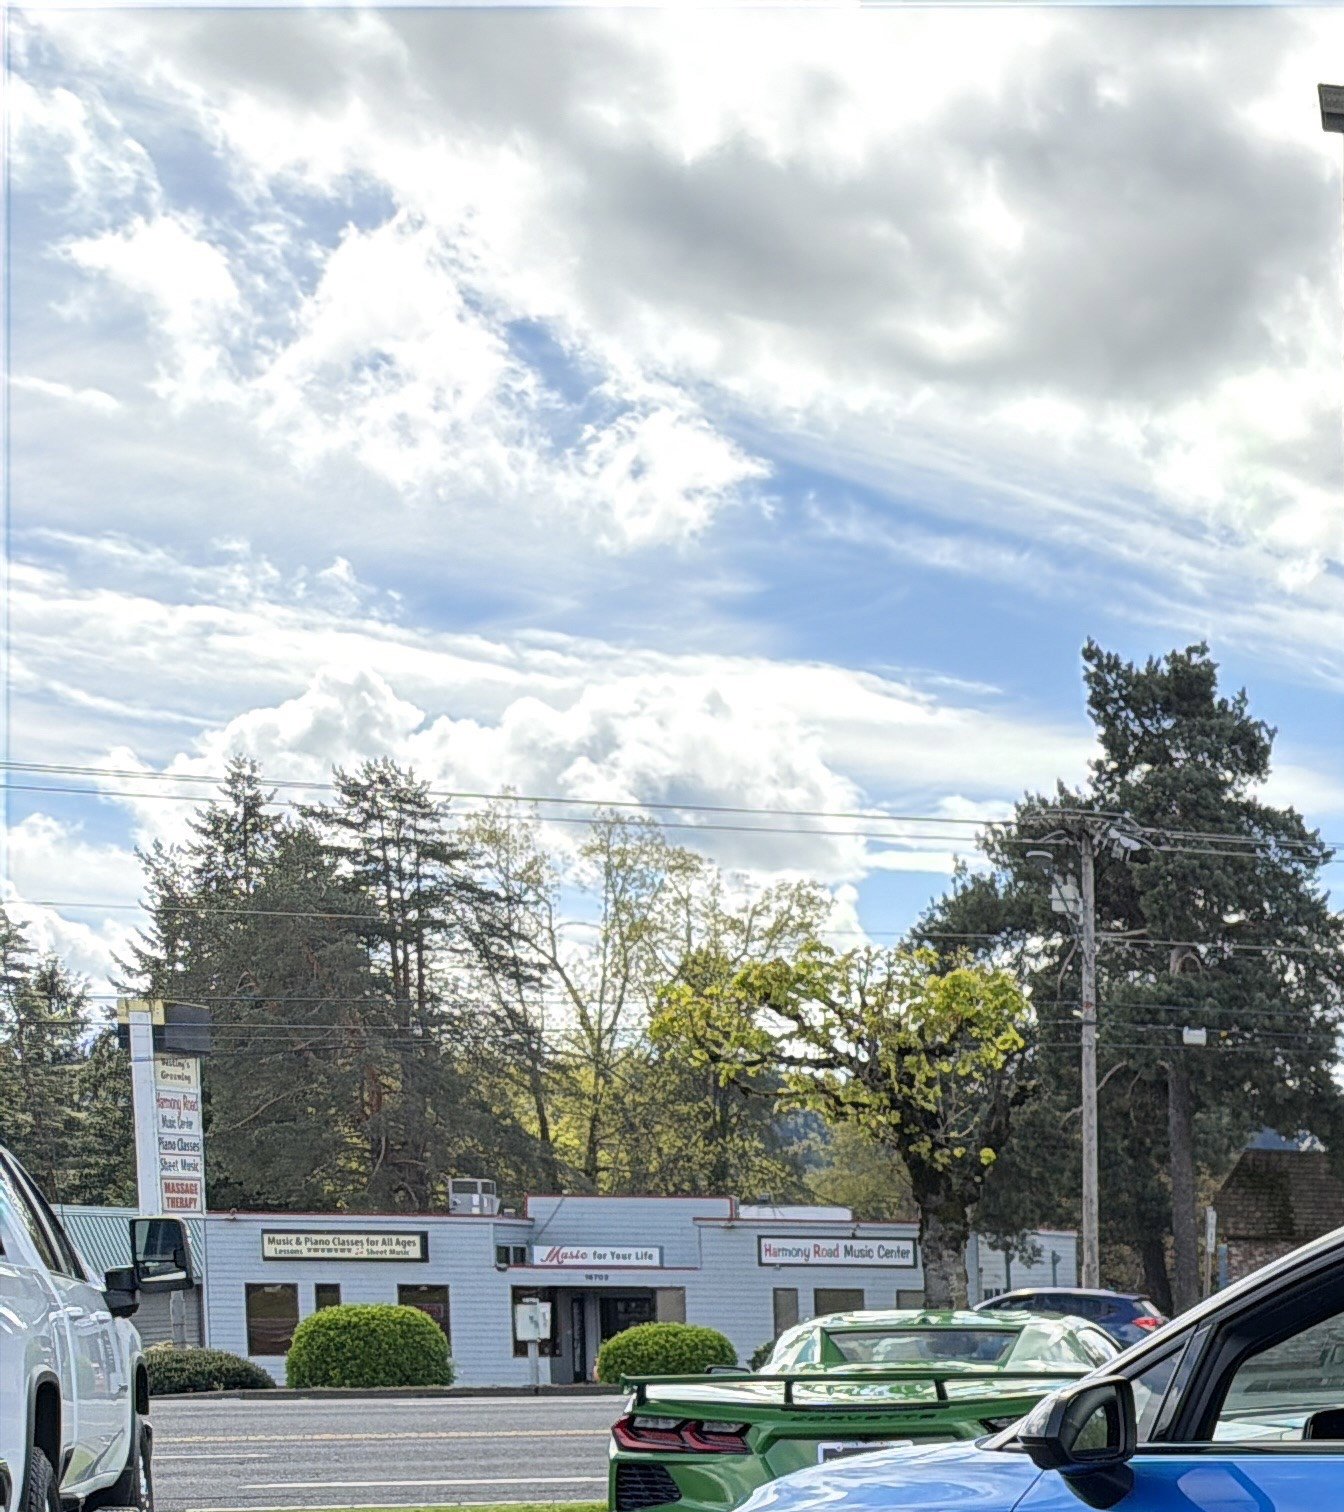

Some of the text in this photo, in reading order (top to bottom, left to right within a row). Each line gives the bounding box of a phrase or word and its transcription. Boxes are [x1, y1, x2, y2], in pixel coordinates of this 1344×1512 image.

[183, 1094, 198, 1111] Road
[161, 1114, 177, 1129] Music
[158, 1136, 200, 1152] Piano Classes
[160, 1158, 199, 1172] Sheet Music
[164, 1181, 198, 1195] MASSAGE
[165, 1196, 197, 1209] THERAPY
[267, 1236, 417, 1250] Music & Piano Classes for All Ages
[274, 1247, 410, 1256] Lessons Sheet Music
[540, 1246, 653, 1265] Music for Your Life
[764, 1243, 911, 1262] Harmony Road Music Center
